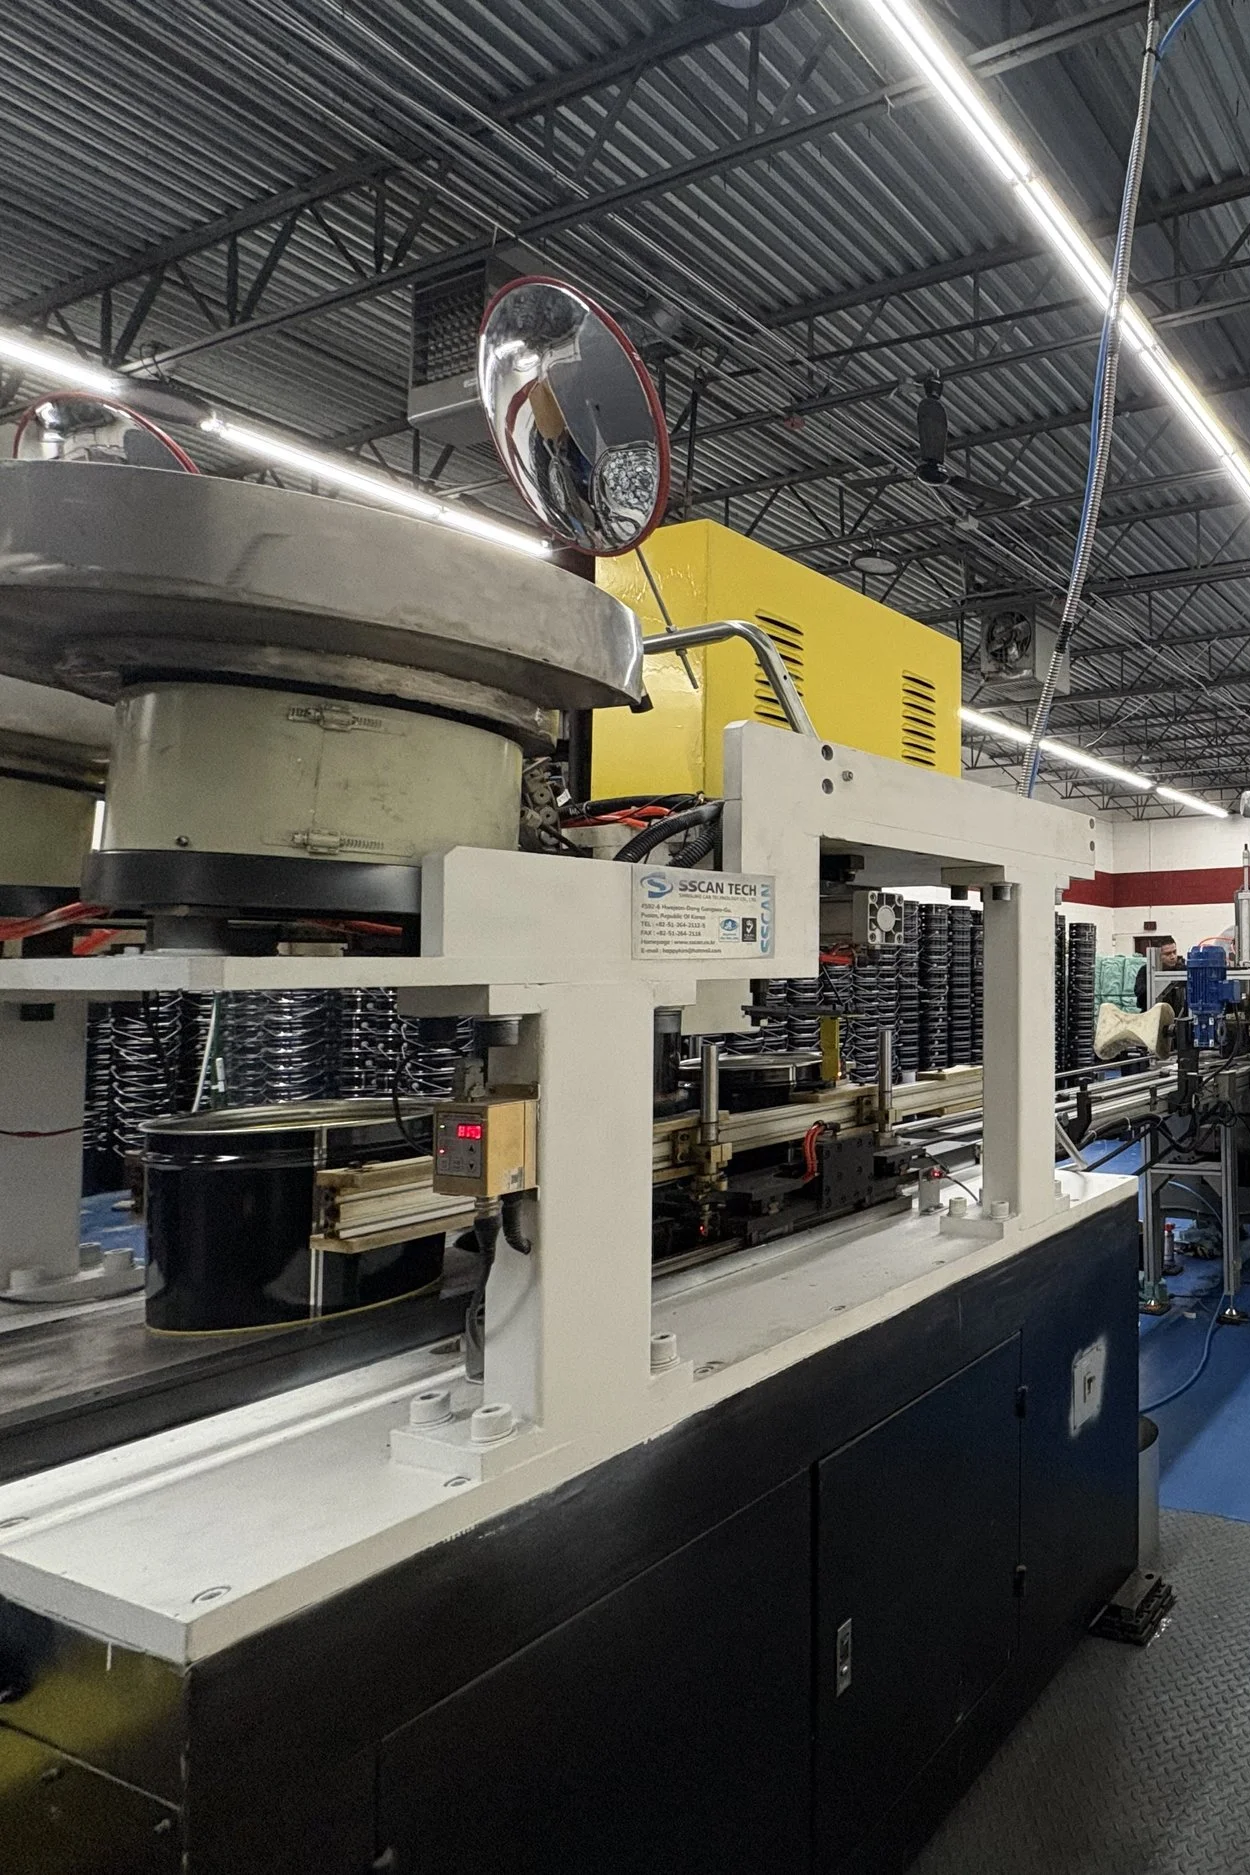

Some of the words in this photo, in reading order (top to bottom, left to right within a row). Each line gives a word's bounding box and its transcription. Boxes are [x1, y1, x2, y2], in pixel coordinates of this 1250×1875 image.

[678, 879, 724, 894] SSCAN
[728, 882, 757, 897] TECH
[761, 884, 771, 953] SSCAN
